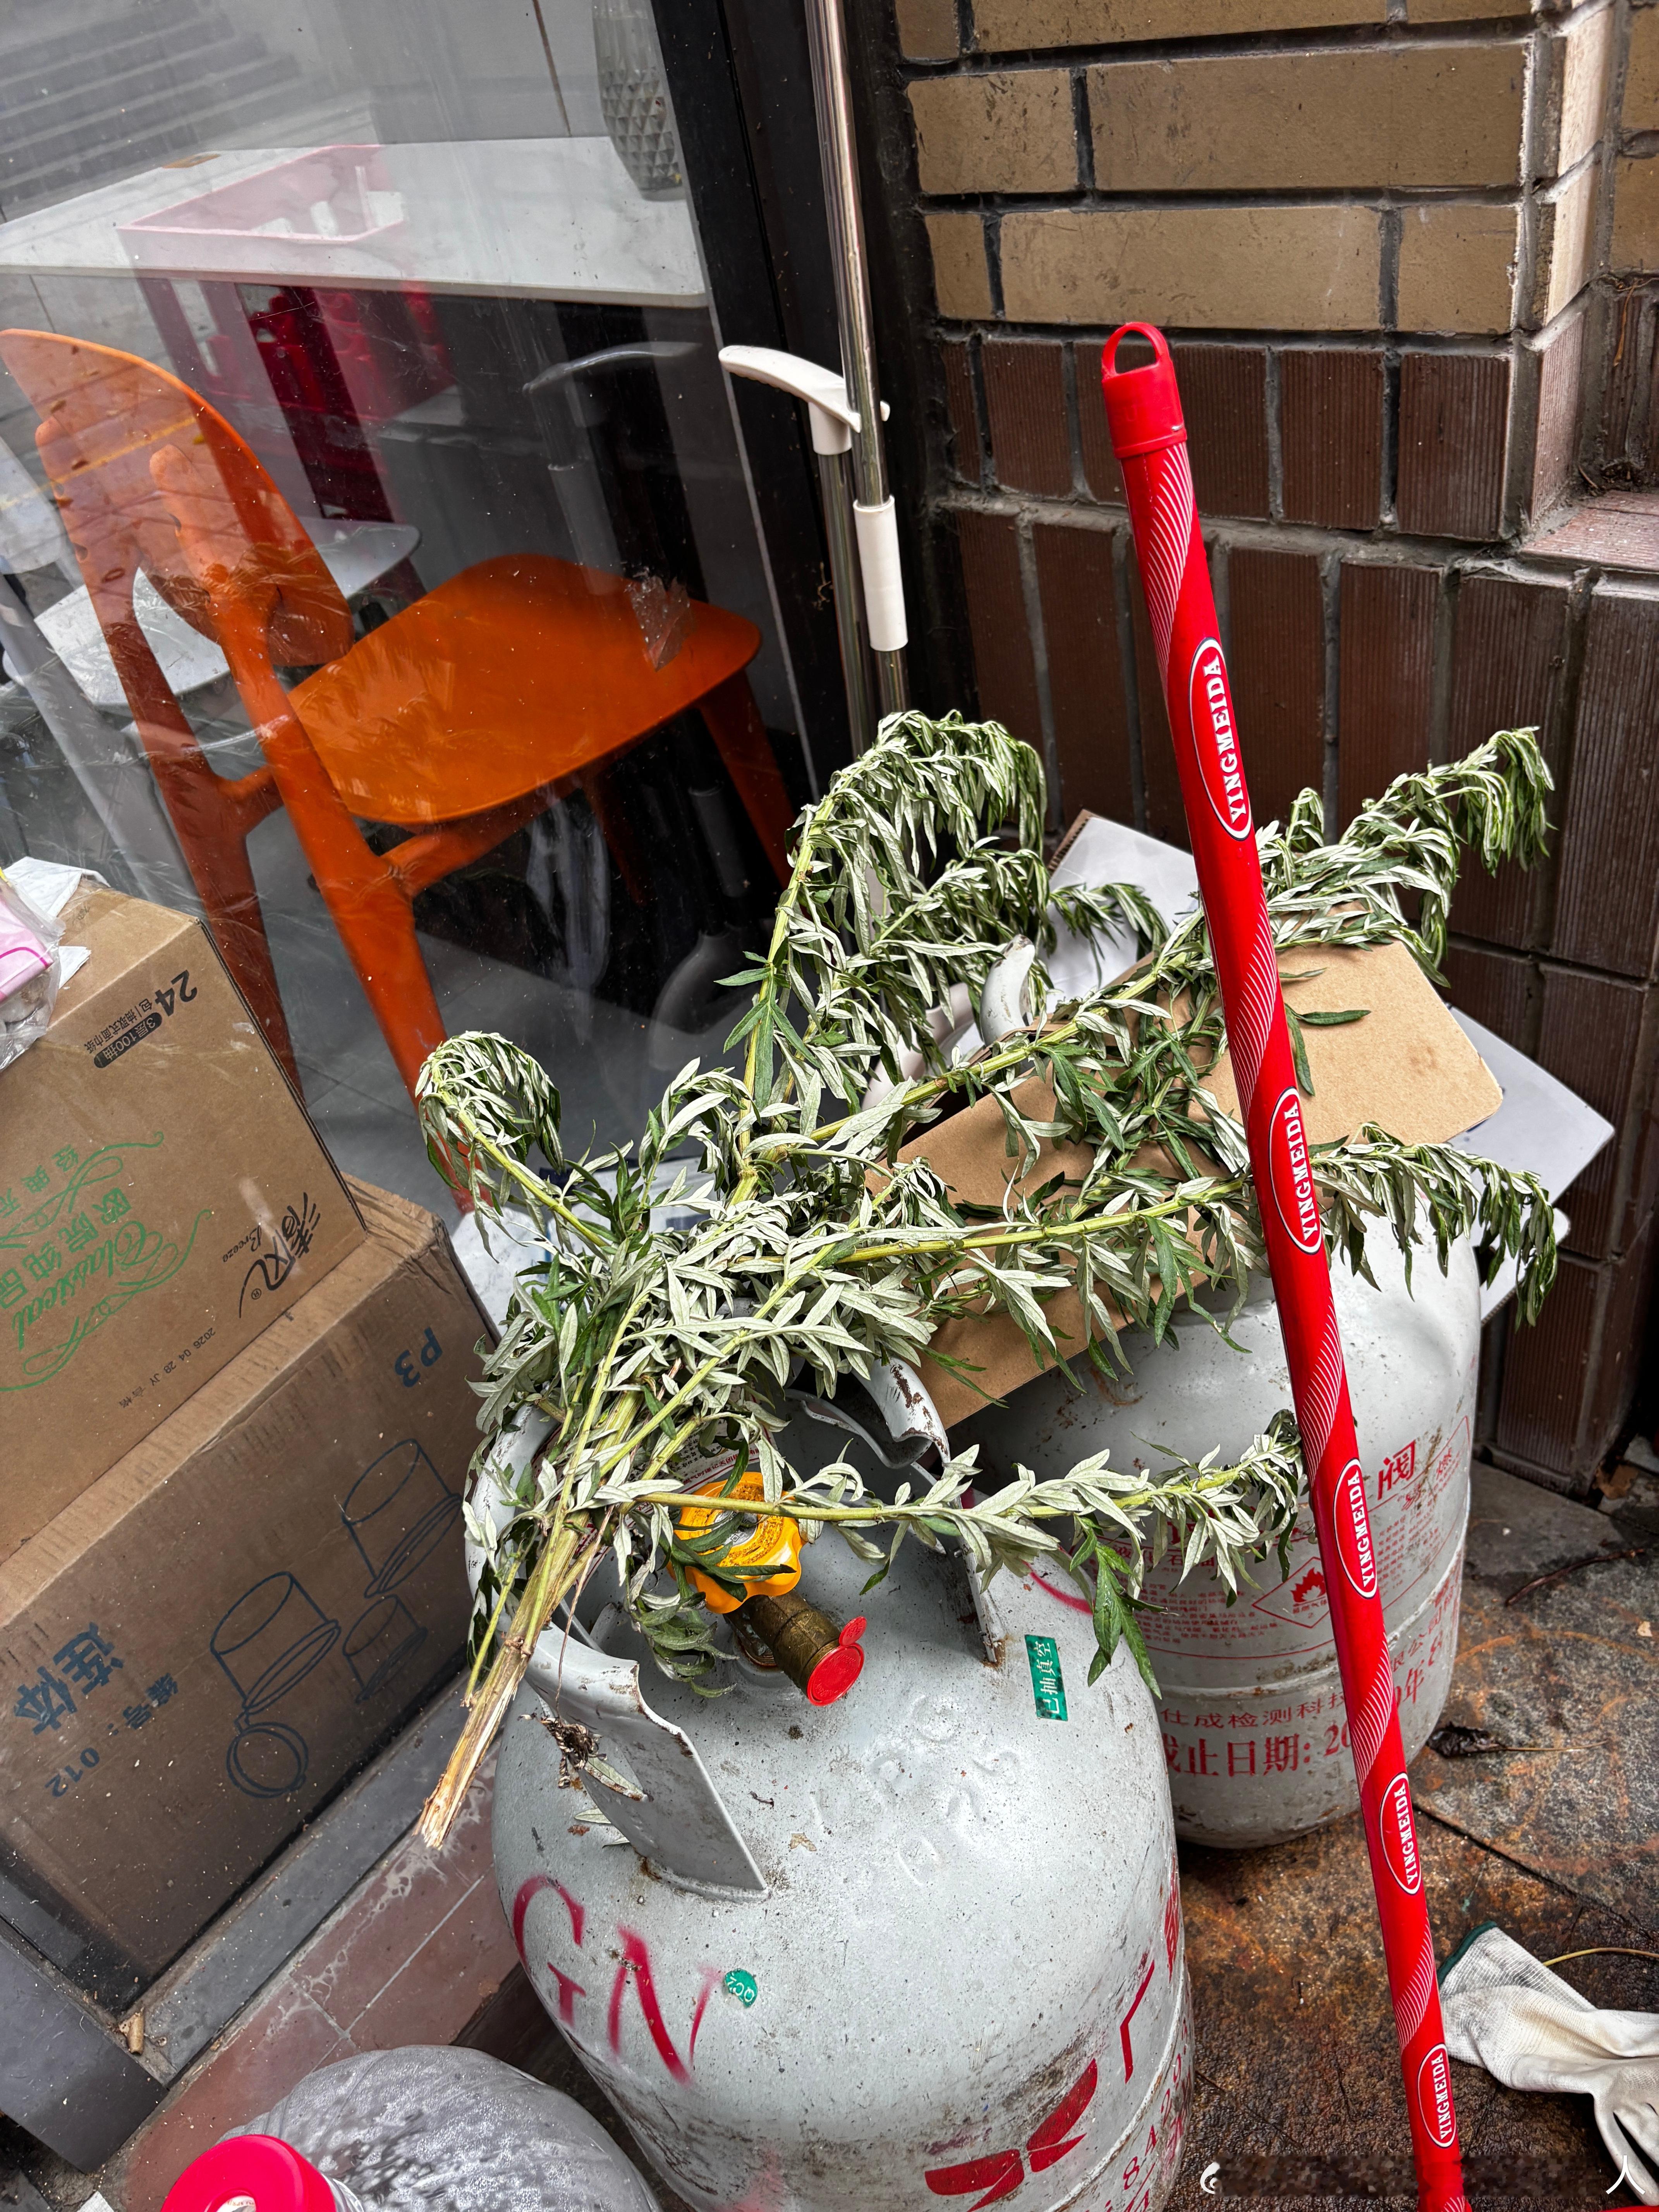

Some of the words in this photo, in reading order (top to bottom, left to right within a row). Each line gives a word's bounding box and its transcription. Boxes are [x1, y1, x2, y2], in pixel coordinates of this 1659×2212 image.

[1203, 654, 1247, 824] YINGMEIDA
[155, 970, 197, 1016] 24
[1283, 1100, 1317, 1241] YINGMEIDA
[222, 1224, 262, 1263] Breeze
[12, 1220, 163, 1351] Classical
[163, 1361, 176, 1374] 28
[179, 1349, 191, 1361] 04
[193, 1327, 216, 1349] 2026
[395, 1327, 443, 1388] P3
[1347, 1470, 1376, 1588] YINGMEIDA
[14, 1621, 124, 1735] 连体
[1034, 1640, 1060, 1714] 已抽真空
[45, 1747, 100, 1798] 012
[1394, 1782, 1418, 1885] YINGMEIDA
[1431, 2052, 1452, 2140] YINGMEIDA
